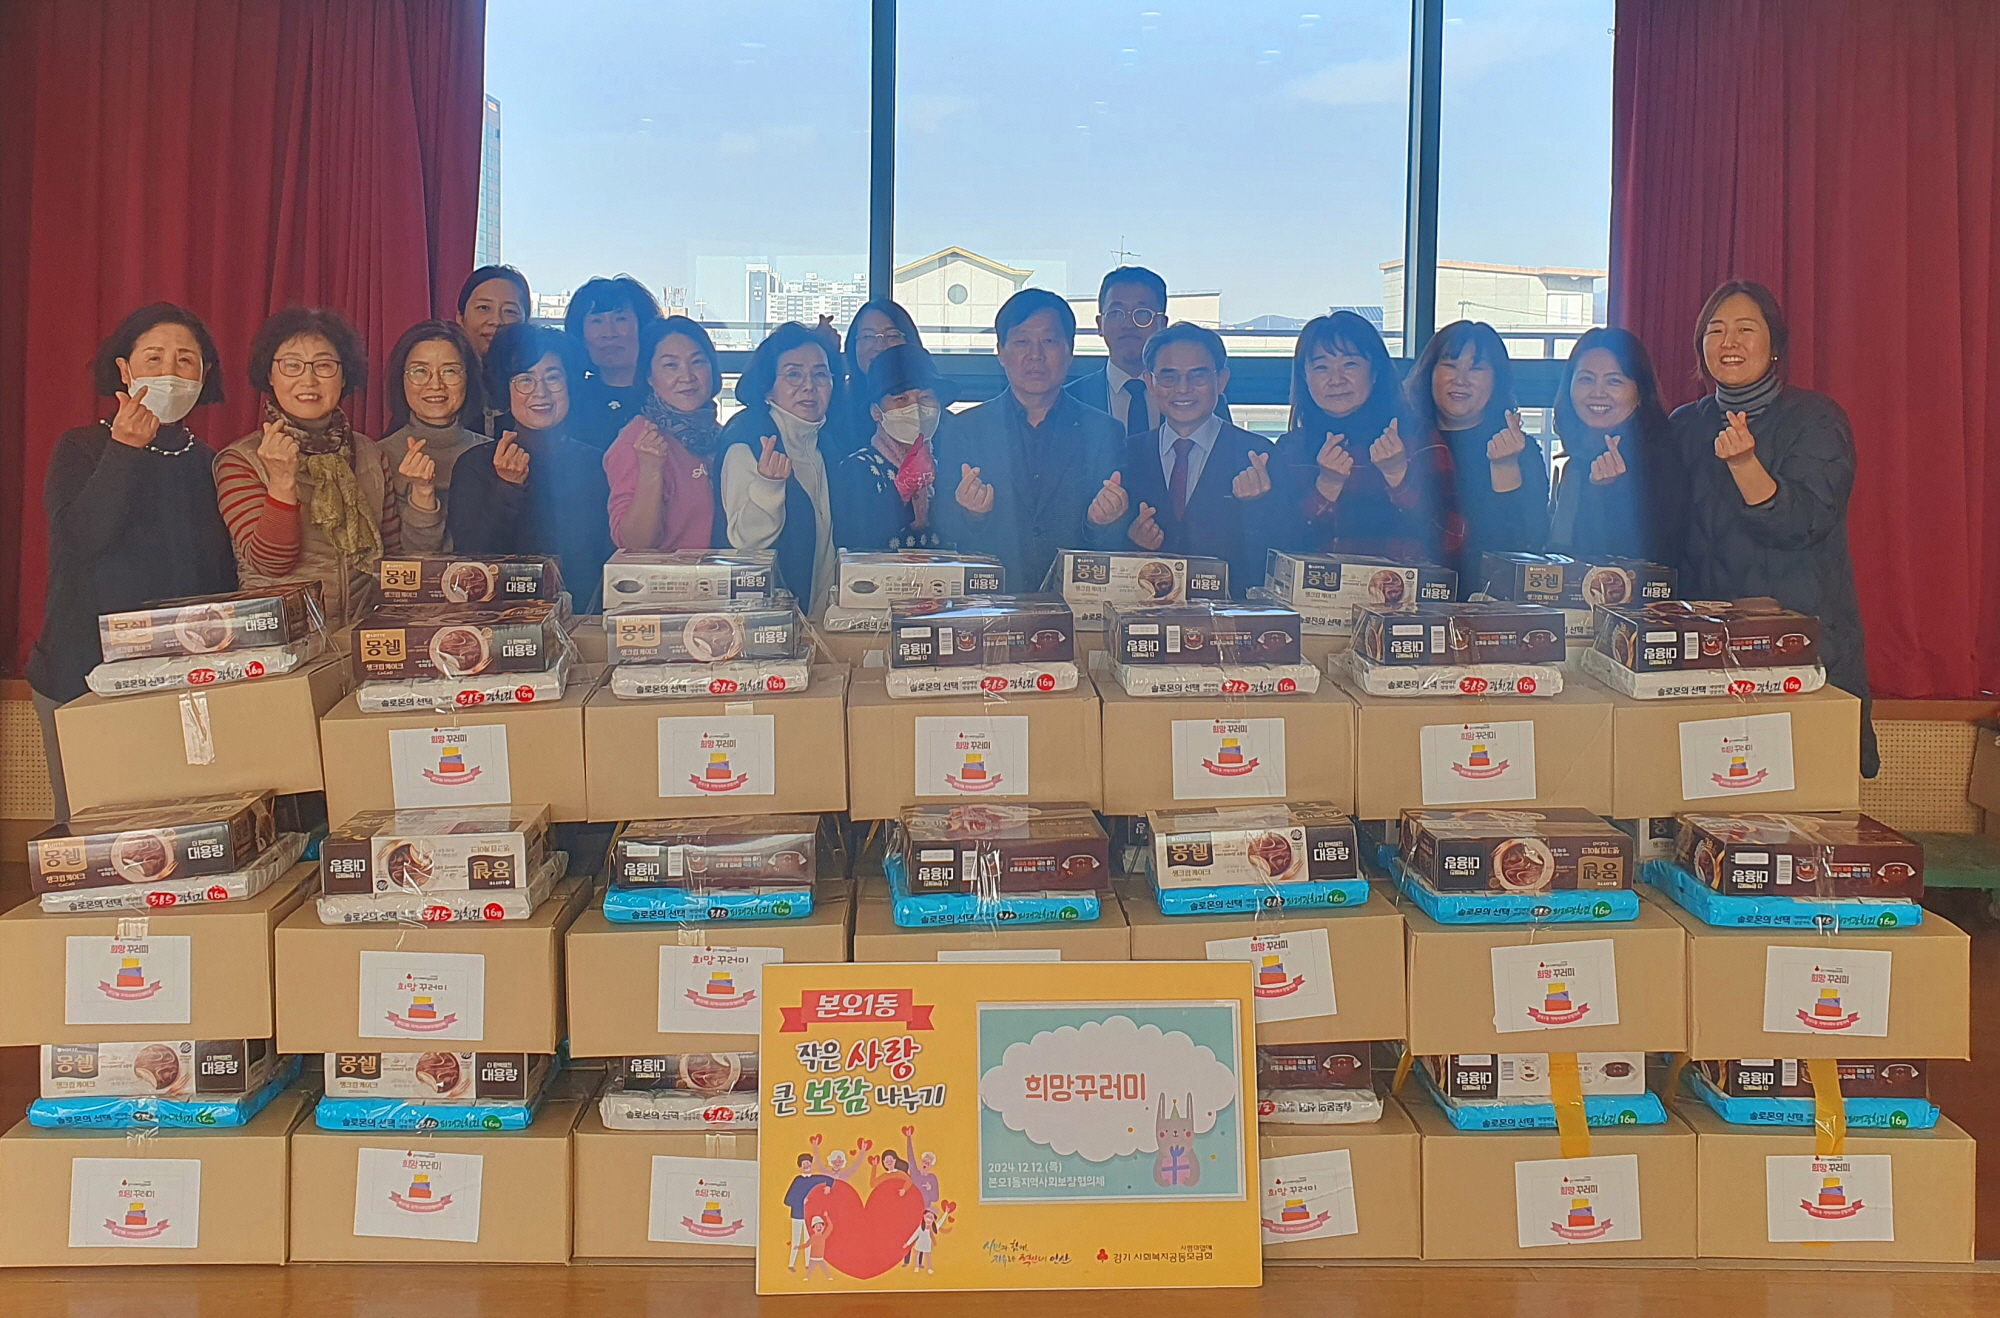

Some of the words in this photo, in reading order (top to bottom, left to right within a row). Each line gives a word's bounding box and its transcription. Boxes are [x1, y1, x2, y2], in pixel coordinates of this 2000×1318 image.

[385, 569, 416, 584] 몽쉘
[1076, 564, 1106, 579] 몽쉘
[736, 577, 765, 587] 대용량
[1307, 570, 1336, 586] 몽쉘
[1528, 573, 1558, 588] 몽쉘
[506, 581, 536, 592] 대용량
[969, 578, 999, 590] 대용량
[1191, 579, 1220, 590] 대용량
[1421, 588, 1449, 600] 대용량
[1642, 587, 1670, 598] 대용량
[246, 616, 278, 632] 대용량
[620, 624, 655, 641] 몽쉘
[755, 631, 787, 643] 대용량
[366, 640, 401, 655] 몽쉘
[503, 644, 537, 657] 대용량
[636, 684, 668, 693] 솔로몬의
[910, 682, 941, 692] 솔로몬의
[943, 681, 958, 690] 선택
[1151, 683, 1182, 692] 솔로몬의
[1185, 682, 1200, 691] 선택
[1388, 680, 1419, 690] 솔로몬의
[1657, 685, 1688, 696] 솔로몬의
[1691, 685, 1706, 694] 선택
[381, 699, 414, 707] 솔로몬의
[416, 698, 433, 706] 선택
[1227, 725, 1247, 733] 꾸러미
[716, 740, 736, 748] 꾸러미
[971, 741, 990, 749] 꾸러미
[44, 848, 81, 867] 몽쉘
[187, 844, 224, 860] 대용량
[1171, 844, 1208, 862] 몽쉘
[1314, 848, 1349, 861] 대용량
[69, 901, 103, 911] 솔로몬의
[105, 899, 122, 908] 선택
[1190, 901, 1223, 910] 솔로몬의
[1226, 899, 1242, 908] 선택
[380, 912, 397, 920] 선택
[632, 910, 665, 919] 솔로몬의
[668, 909, 685, 919] 선택
[1493, 907, 1509, 915] 선택
[921, 914, 954, 924] 솔로몬의
[957, 914, 974, 923] 선택
[1738, 915, 1770, 924] 솔로몬의
[1774, 915, 1790, 924] 선택
[127, 945, 148, 954] 꾸러미
[1251, 943, 1265, 952] 희망
[1267, 940, 1288, 950] 꾸러미
[692, 955, 715, 965] 희망
[718, 956, 748, 964] 꾸러미
[1553, 968, 1575, 977] 꾸러미
[397, 983, 417, 992] 희망
[419, 983, 447, 991] 꾸러미
[816, 991, 898, 1018] 본오1동
[56, 1056, 93, 1073] 몽쉘
[339, 1056, 375, 1072] 몽쉘
[797, 1040, 840, 1072] 작은
[845, 1038, 920, 1080] 사랑
[201, 1061, 238, 1075] 대용량
[482, 1069, 518, 1081] 대용량
[1025, 1073, 1146, 1102] 희망꾸러미
[772, 1083, 796, 1116] 큰
[805, 1081, 869, 1115] 보람
[875, 1083, 946, 1112] 나누기
[1750, 1112, 1783, 1121] 솔로몬의
[1787, 1113, 1803, 1121] 선택
[342, 1118, 375, 1127] 솔로몬의
[378, 1119, 395, 1128] 선택
[1482, 1118, 1516, 1127] 솔로몬의
[1518, 1118, 1534, 1127] 선택
[1812, 1163, 1827, 1172] 희망
[1829, 1163, 1850, 1172] 꾸러미
[988, 1176, 1105, 1188] 본오1동지역사회보장협의체
[1268, 1188, 1287, 1196] 희망
[1290, 1185, 1317, 1194] 꾸러미
[1577, 1185, 1597, 1194] 꾸러미
[1050, 1253, 1072, 1264] 안산
[1114, 1254, 1130, 1263] 경기
[1134, 1252, 1212, 1263] 사회복지공동모금회
